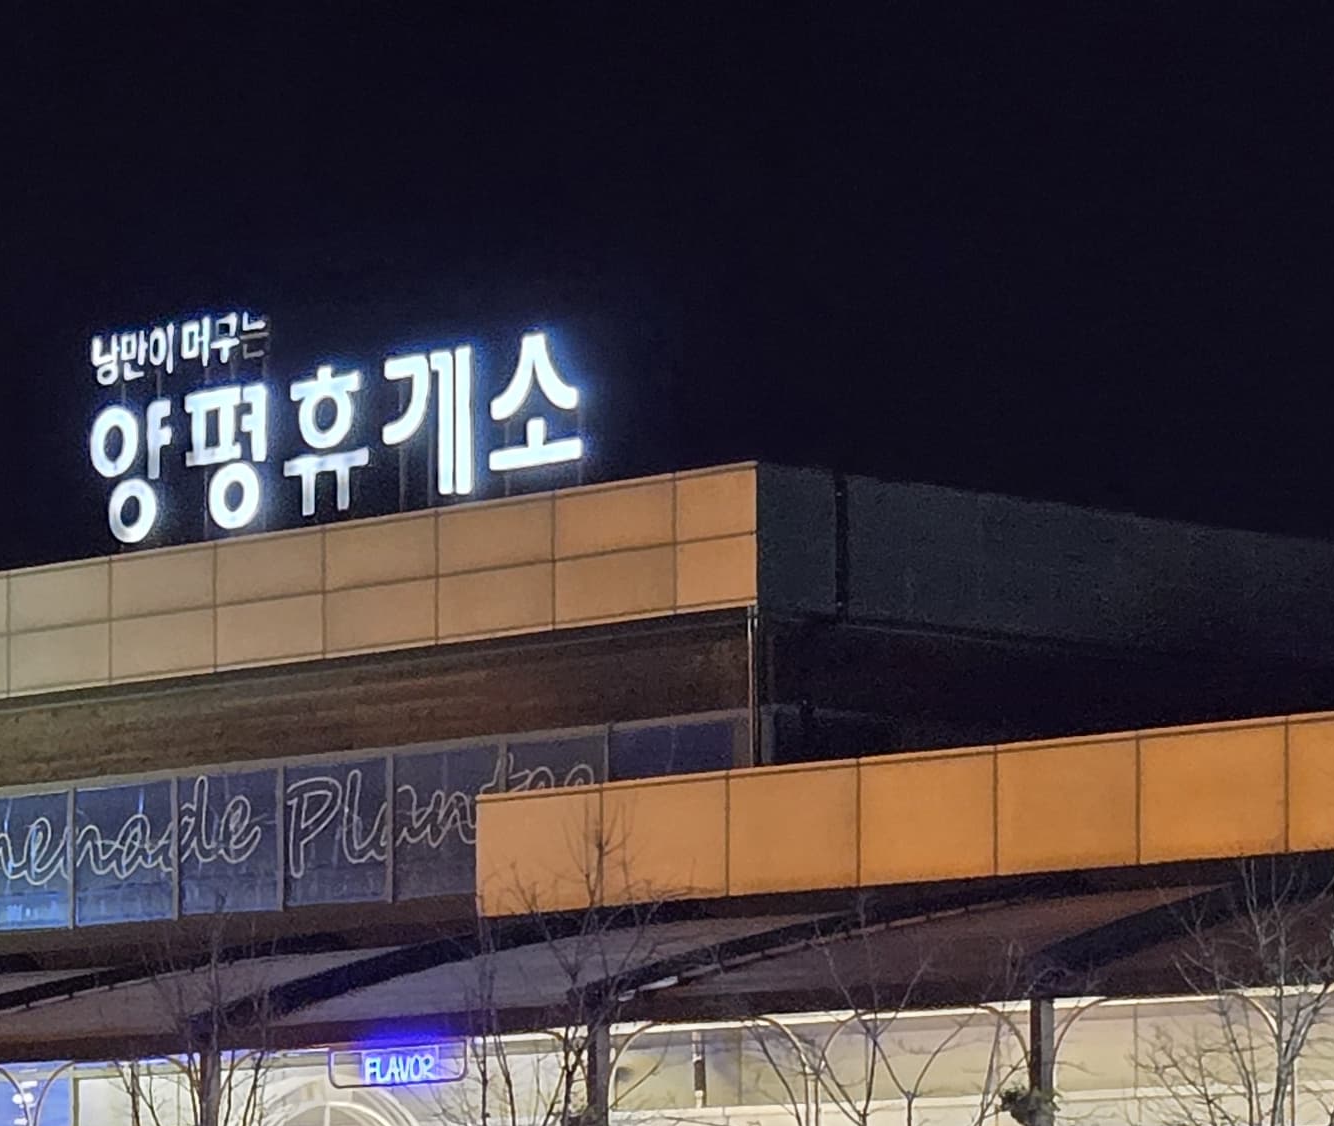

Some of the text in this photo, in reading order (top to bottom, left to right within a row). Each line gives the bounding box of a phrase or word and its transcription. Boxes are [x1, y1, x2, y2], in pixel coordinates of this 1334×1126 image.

[90, 322, 175, 386] 낭만이
[89, 331, 584, 544] 양평휴게소
[364, 1054, 436, 1085] FLAVOR
